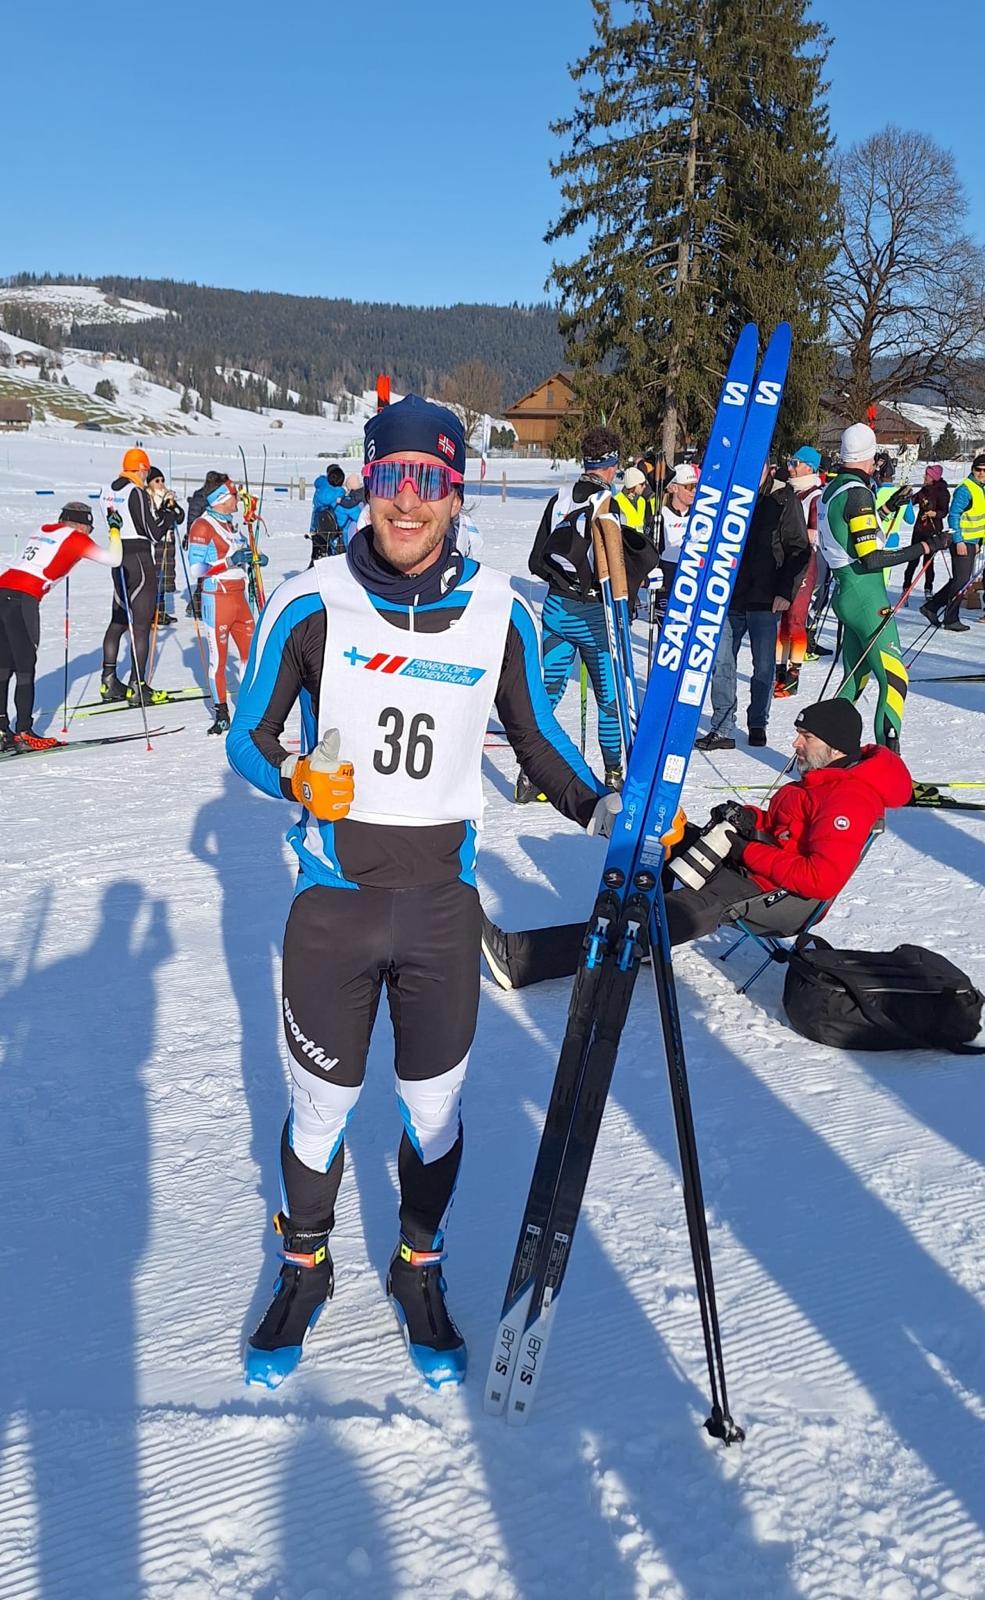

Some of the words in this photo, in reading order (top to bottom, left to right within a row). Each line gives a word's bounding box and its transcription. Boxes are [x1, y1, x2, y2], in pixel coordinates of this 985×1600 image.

[656, 485, 722, 672] SALOMON
[688, 485, 756, 673] SALOMON
[404, 667, 475, 685] ROTHENTHURM
[410, 659, 473, 676] FINNENLOIPE
[373, 706, 436, 780] 36
[284, 997, 340, 1072] sportful
